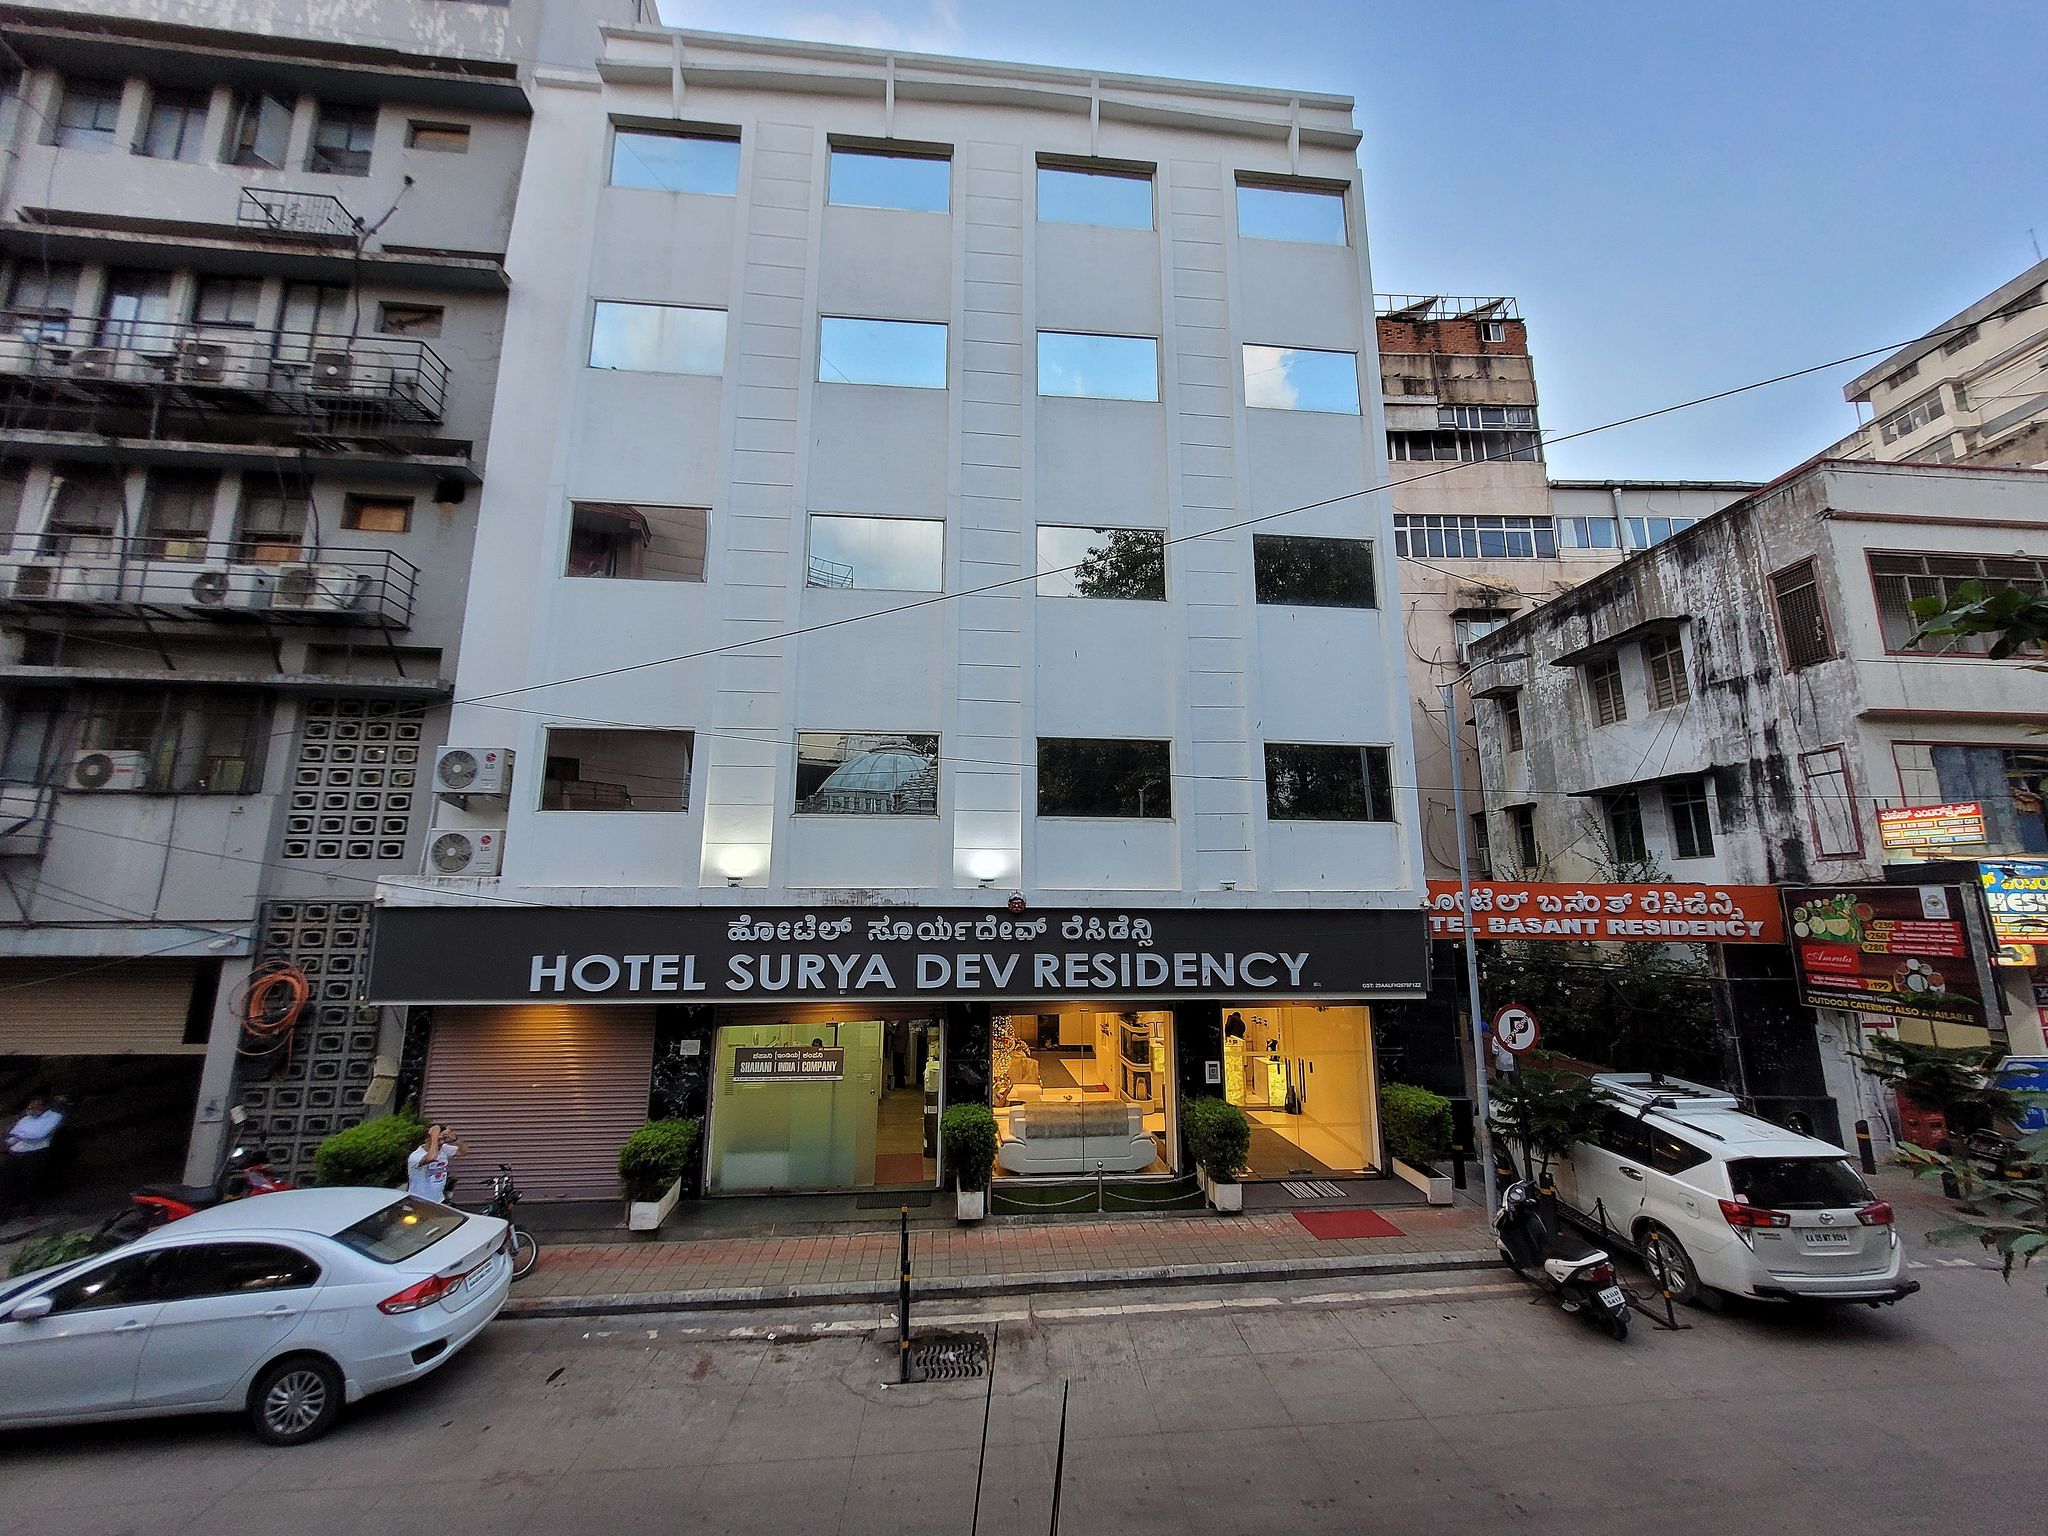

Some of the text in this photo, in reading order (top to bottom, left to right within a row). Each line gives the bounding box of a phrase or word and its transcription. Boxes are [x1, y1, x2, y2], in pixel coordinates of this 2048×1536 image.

[727, 914, 852, 941] ಹೋಟೆಲ್
[1488, 917, 1599, 935] BASANT
[1606, 919, 1764, 937] RESIDENCY
[529, 952, 1309, 992] HOTEL SURYA DEV RESIDENCY
[1808, 995, 1849, 1008] OUTDOOR
[1850, 1000, 1893, 1014] CATERING
[1895, 1006, 1919, 1016] ALSO
[801, 1060, 838, 1072] COMPANY
